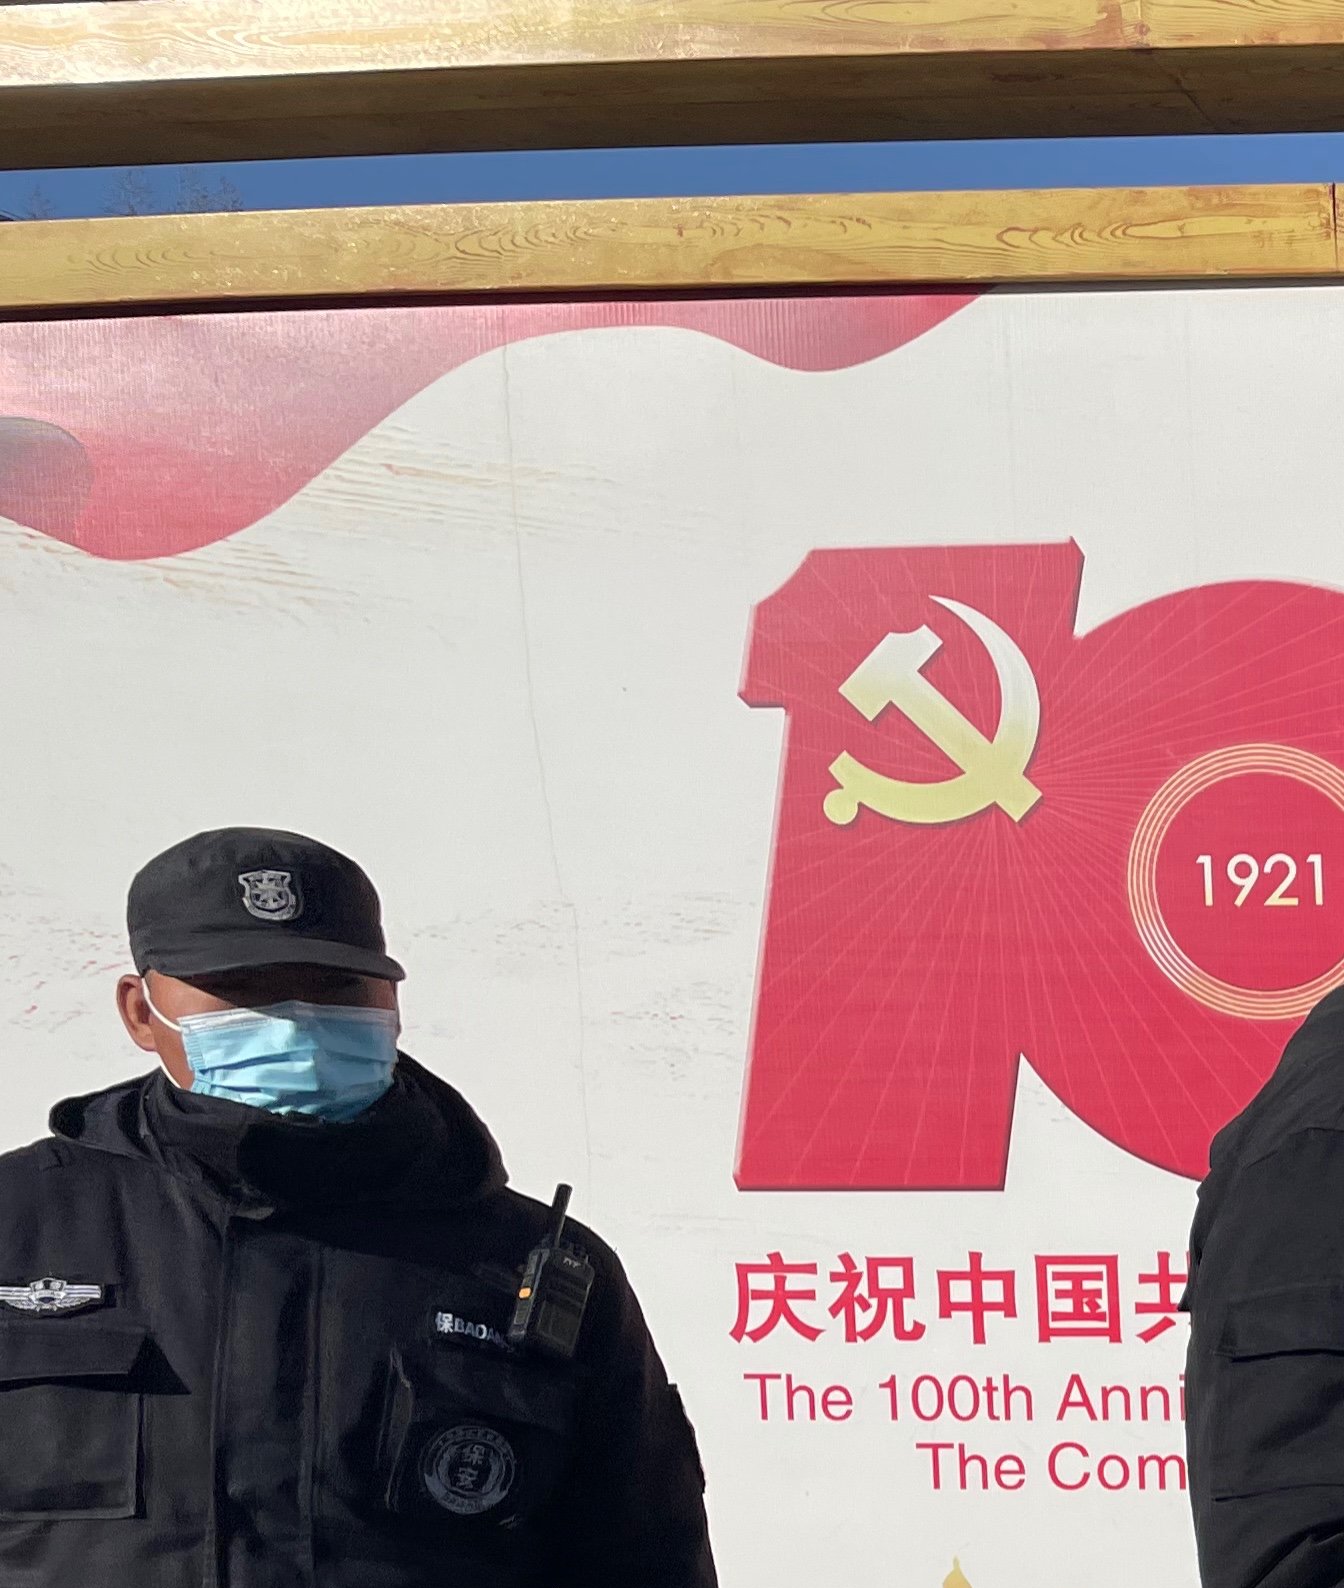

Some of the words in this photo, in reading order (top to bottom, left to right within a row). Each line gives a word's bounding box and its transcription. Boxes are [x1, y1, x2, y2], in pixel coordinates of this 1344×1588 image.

[1195, 852, 1324, 908] 1921
[729, 1251, 1190, 1345] 庆祝中国共
[744, 1372, 853, 1421] The
[879, 1373, 1033, 1421] 100th
[915, 1442, 1025, 1490] The
[1047, 1441, 1187, 1491] Com
